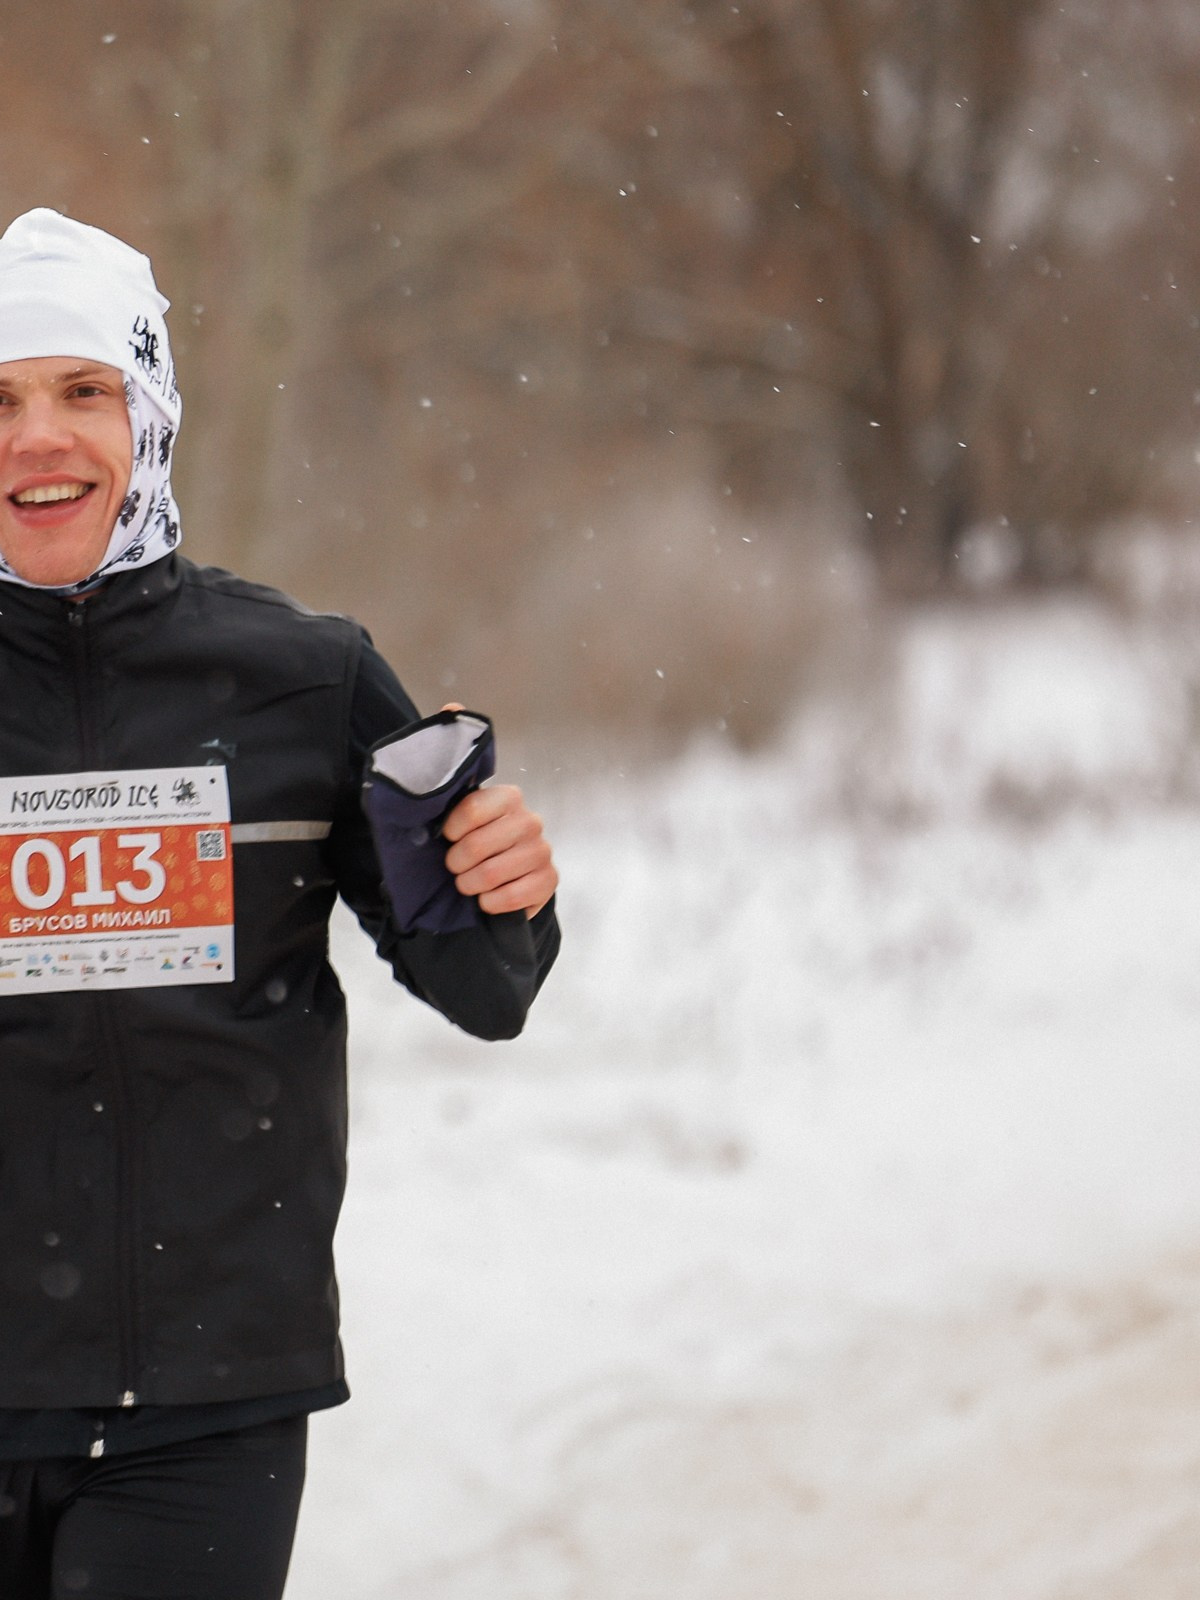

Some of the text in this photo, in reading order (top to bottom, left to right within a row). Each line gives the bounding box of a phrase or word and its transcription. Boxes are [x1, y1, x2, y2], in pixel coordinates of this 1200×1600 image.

[10, 832, 166, 911] 013
[9, 909, 171, 933] БРУСОВ МИХАИЛ
